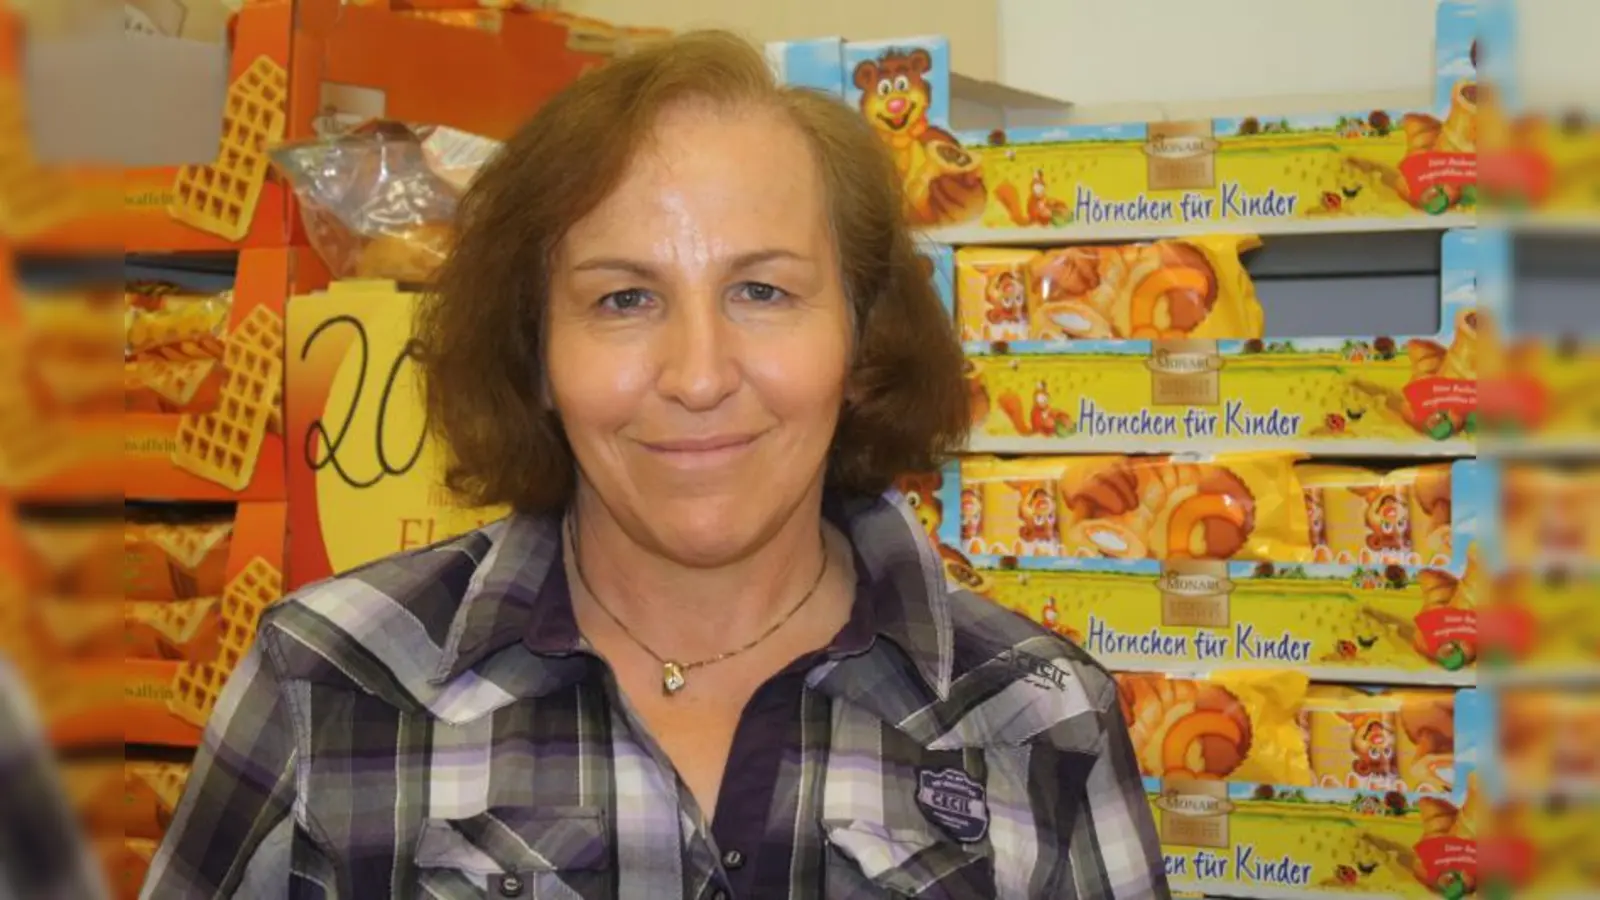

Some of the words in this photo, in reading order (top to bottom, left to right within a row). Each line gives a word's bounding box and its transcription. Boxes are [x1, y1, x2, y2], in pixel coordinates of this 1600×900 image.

[1075, 185, 1173, 225] Hörnchen
[1180, 192, 1214, 222] für
[1221, 182, 1297, 218] Kinder
[1079, 397, 1177, 437] Hörnchen
[1183, 407, 1218, 437] für
[1225, 399, 1301, 437] Kinder
[1088, 615, 1187, 655] Hörnchen
[1193, 630, 1228, 659] für
[1235, 622, 1312, 661] Kinder
[1192, 851, 1228, 879] für
[1235, 845, 1312, 884] Kinder
